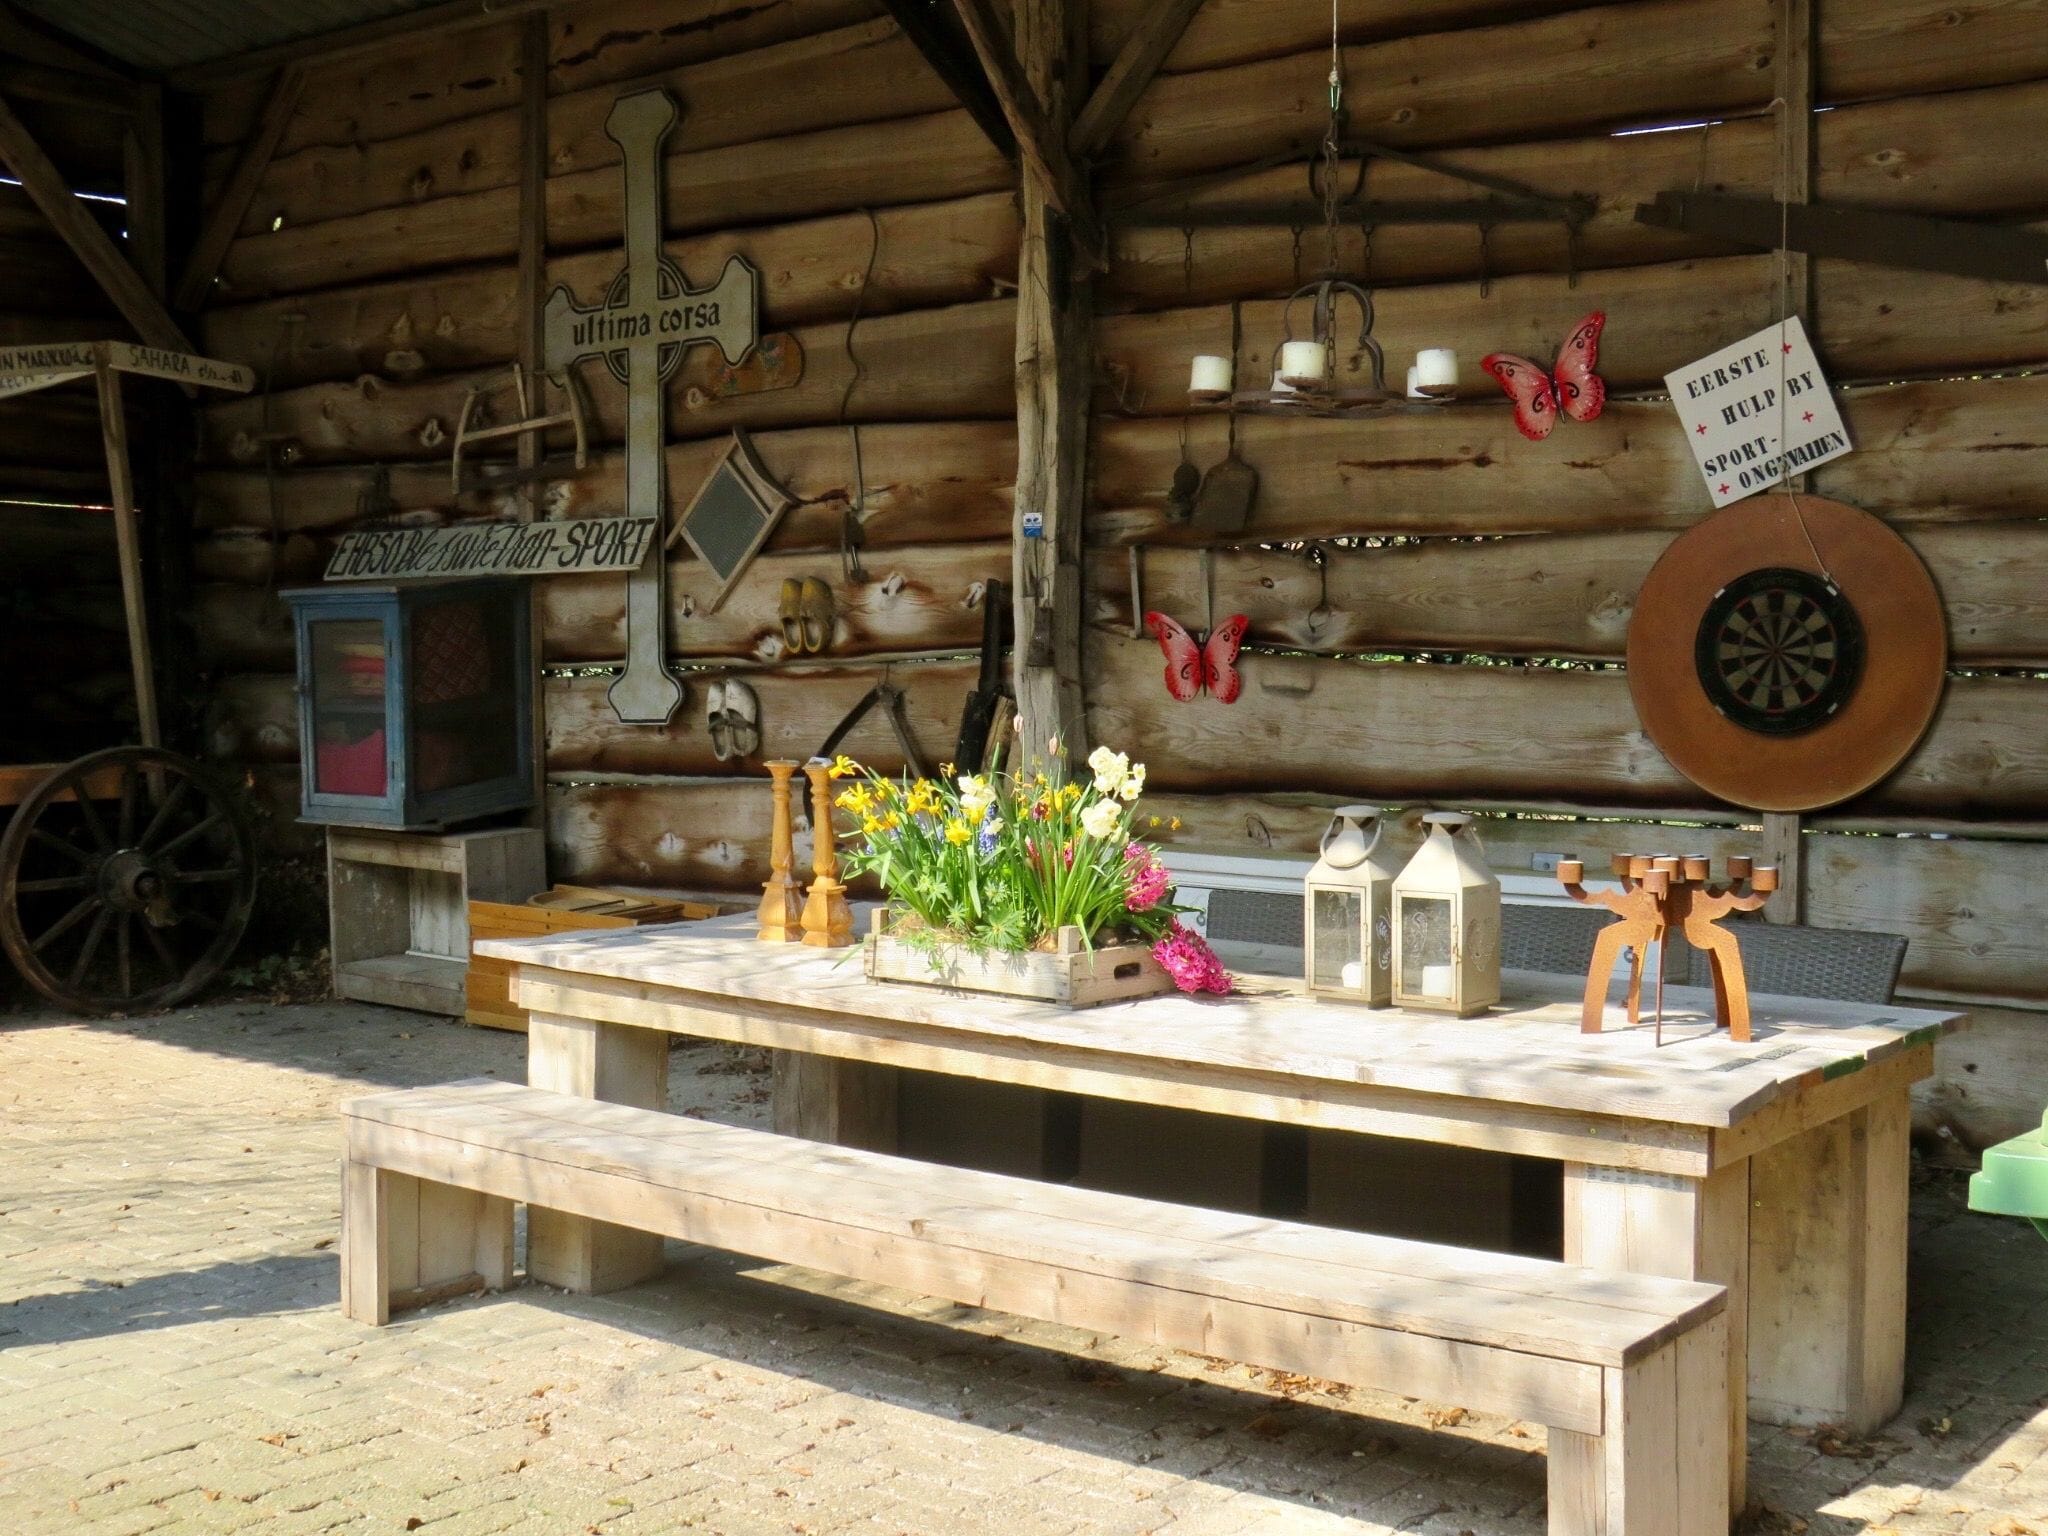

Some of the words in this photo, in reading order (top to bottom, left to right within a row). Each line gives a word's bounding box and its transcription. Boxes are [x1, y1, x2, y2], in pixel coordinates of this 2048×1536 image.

[573, 312, 651, 346] ultima
[659, 301, 721, 333] corsa
[130, 350, 191, 375] SAHARA
[1685, 349, 1770, 399] EERSTE
[1720, 388, 1776, 425] HULP
[1786, 370, 1815, 397] BY
